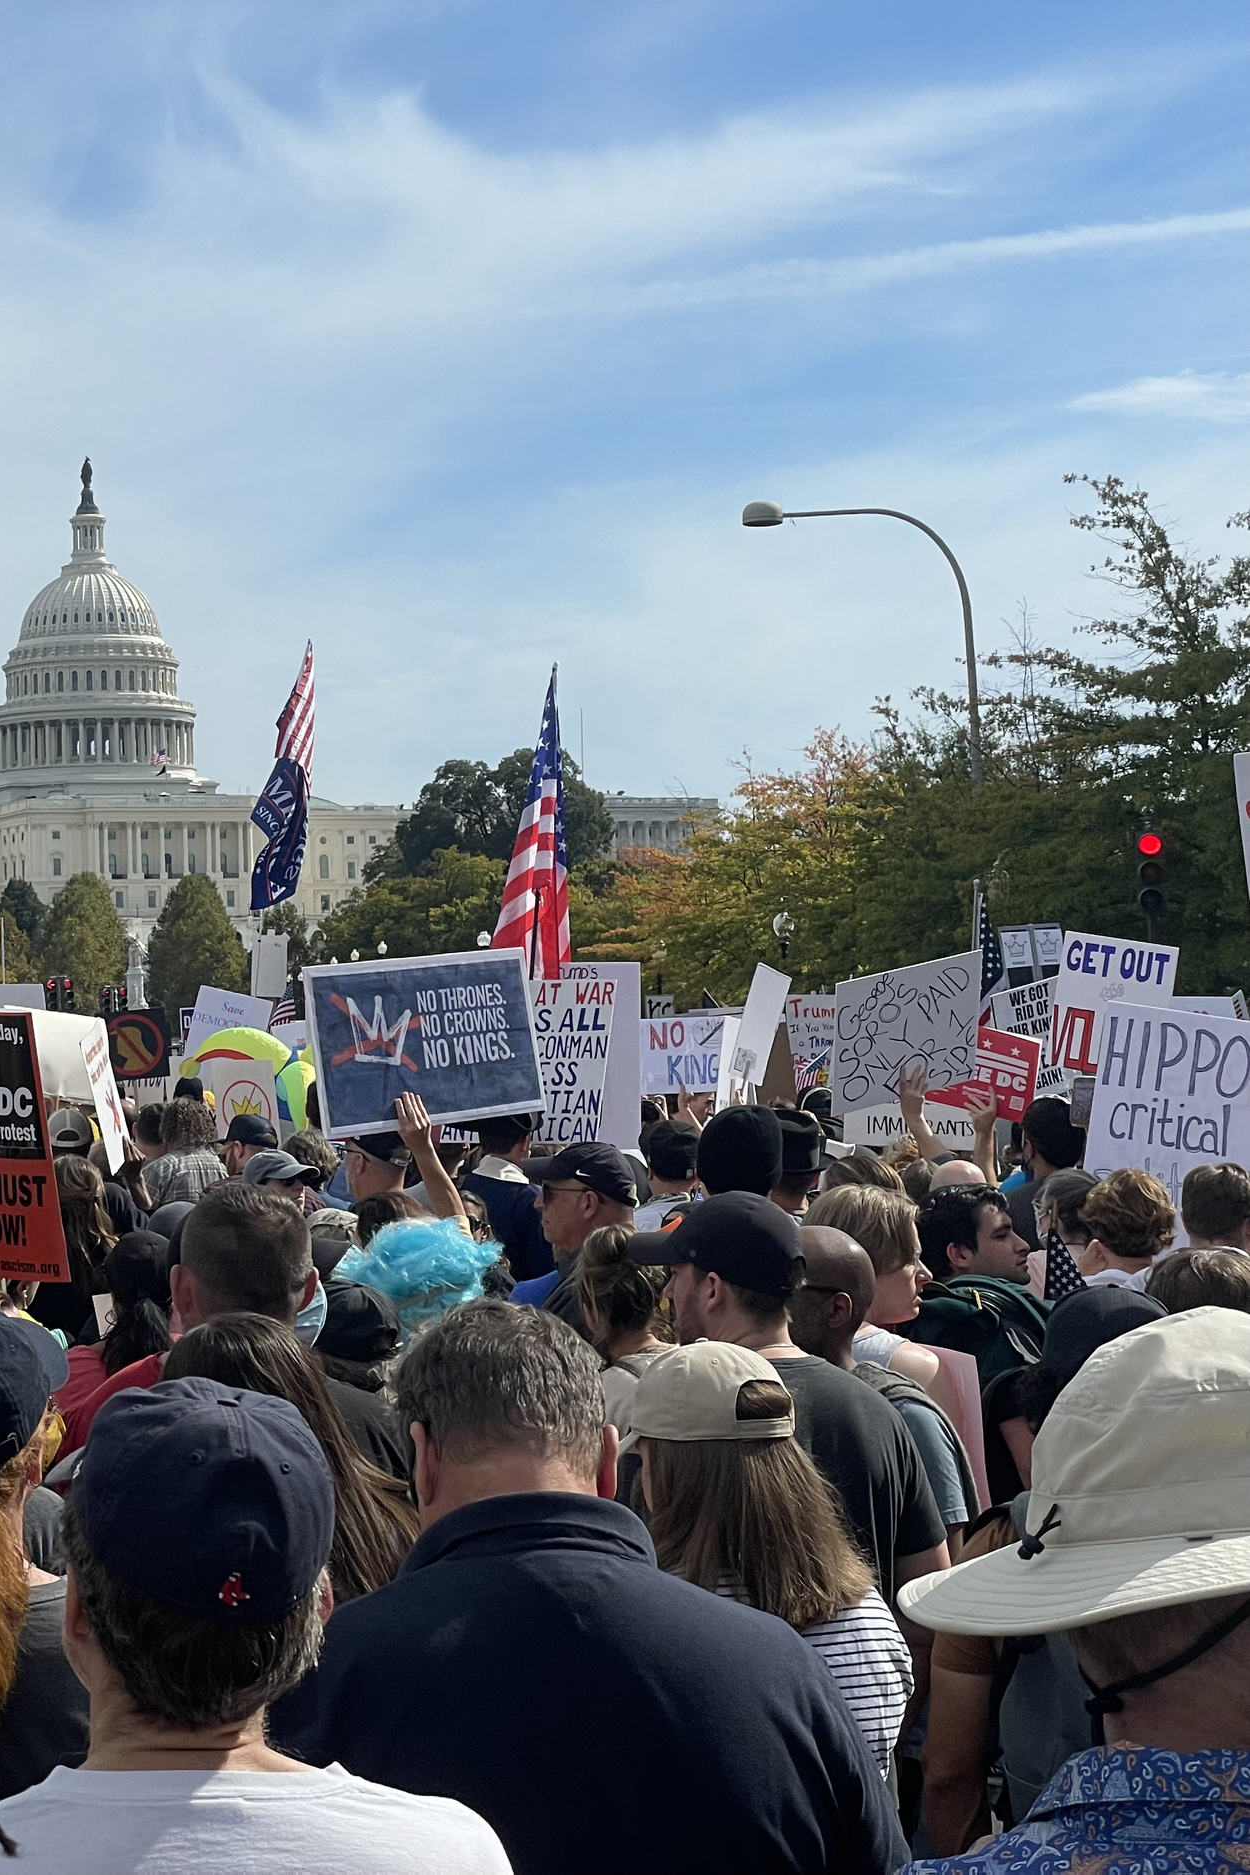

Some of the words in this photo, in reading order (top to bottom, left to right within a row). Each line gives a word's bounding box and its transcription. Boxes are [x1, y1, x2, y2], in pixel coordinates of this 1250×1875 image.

[1066, 939, 1116, 978] GET
[1120, 948, 1171, 985] OUT
[416, 989, 438, 1014] NO
[438, 983, 507, 1011] THRONES.
[535, 982, 561, 1006] AT
[576, 982, 615, 1006] WAR
[916, 966, 970, 1025] PAID
[1009, 990, 1026, 1007] WE
[1028, 983, 1049, 1004] GOT
[221, 1001, 245, 1016] Save
[419, 1013, 441, 1038] NO
[444, 1007, 510, 1035] CROWNS.
[558, 1008, 606, 1033] ALL
[1015, 1006, 1034, 1022] RID
[1036, 1000, 1049, 1016] OF
[650, 1020, 685, 1051] NO
[1031, 1015, 1052, 1036] KIN
[422, 1038, 450, 1069] NO
[453, 1031, 515, 1065] KINGS.
[1101, 1016, 1250, 1098] HIPPO
[995, 1071, 1027, 1092] DC
[545, 1089, 601, 1115] TIAN
[1109, 1096, 1232, 1157] critical
